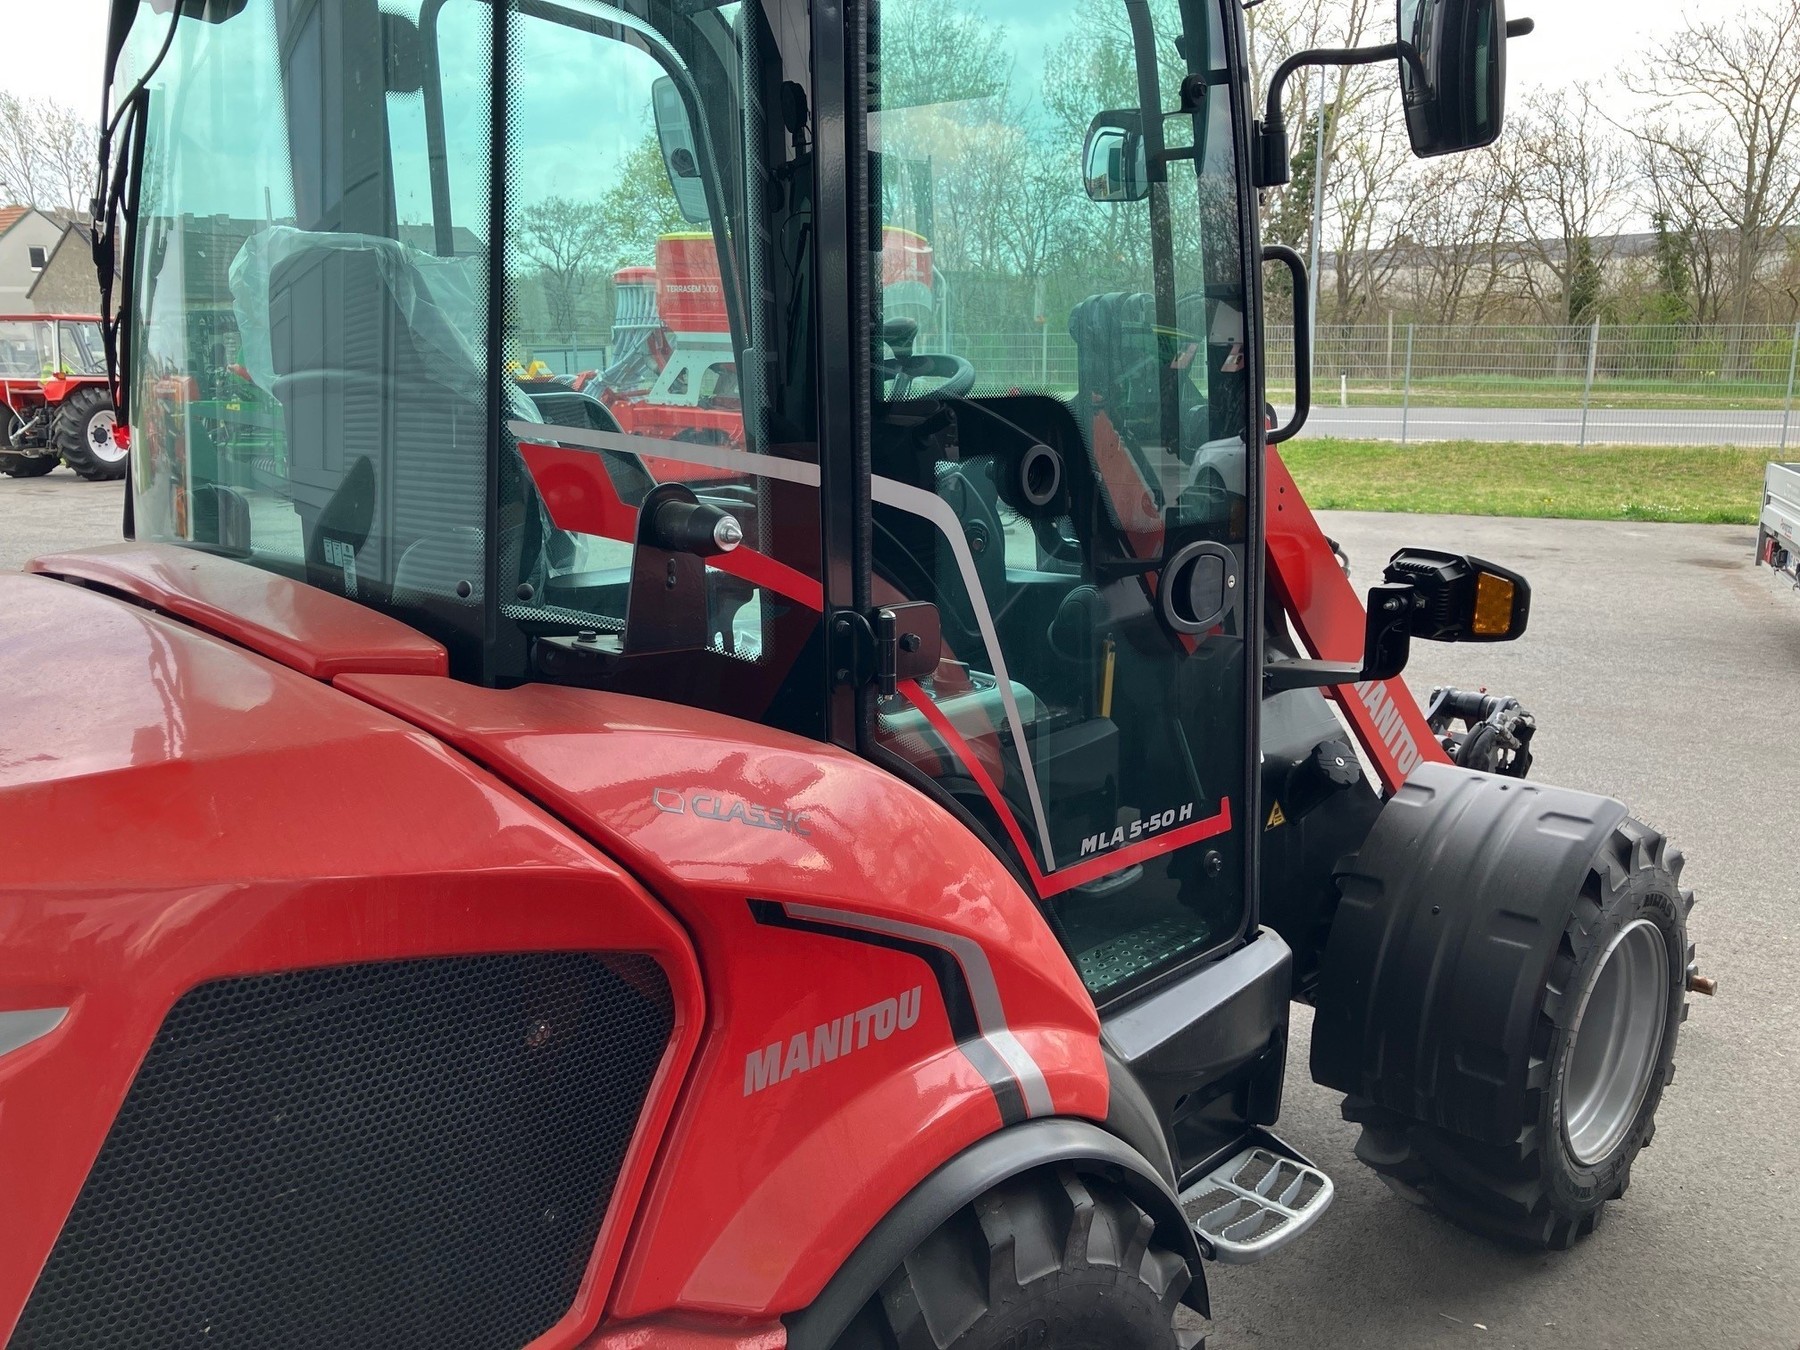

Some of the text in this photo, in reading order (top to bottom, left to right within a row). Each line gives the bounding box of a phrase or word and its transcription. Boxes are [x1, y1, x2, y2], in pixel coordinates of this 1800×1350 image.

[666, 284, 701, 293] TERRASEM
[692, 794, 811, 836] CLASSIC
[1080, 803, 1193, 856] MLA 5-50 H
[743, 985, 922, 1098] MANITOU
